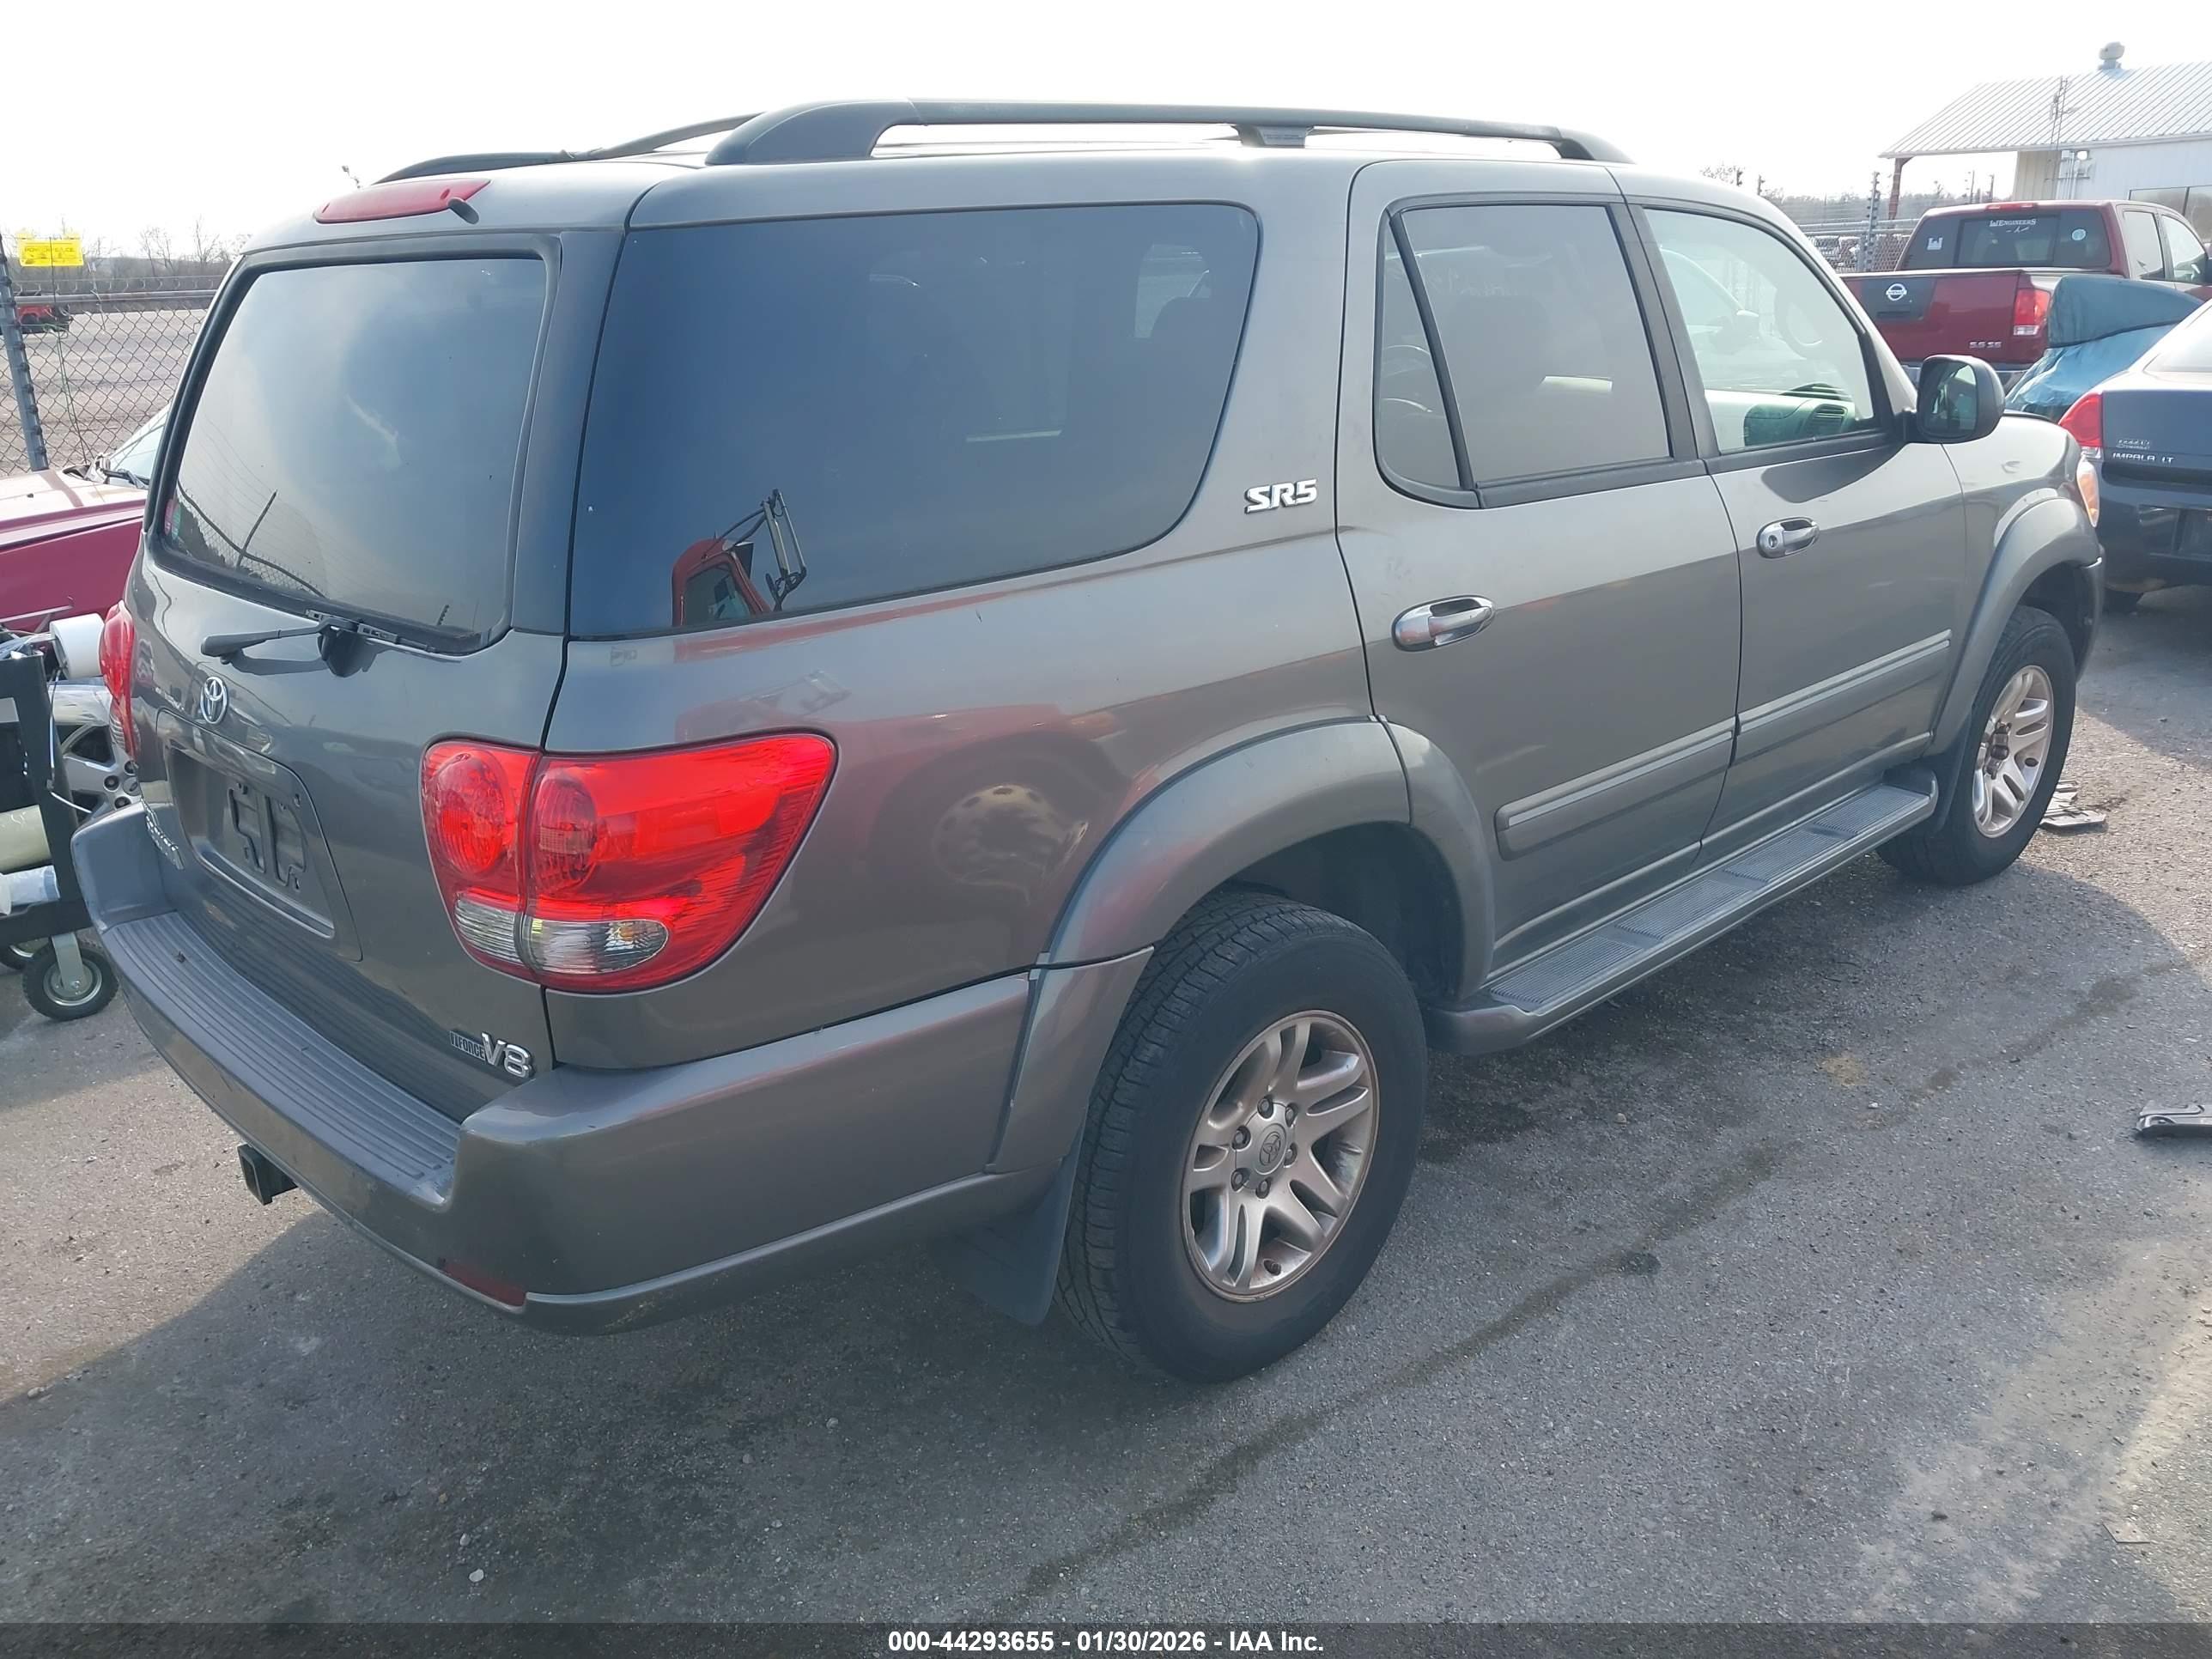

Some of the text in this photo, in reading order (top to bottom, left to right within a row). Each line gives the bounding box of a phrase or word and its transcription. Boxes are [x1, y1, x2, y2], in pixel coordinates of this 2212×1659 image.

[2113, 453, 2155, 461] IMPALA
[1245, 479, 1317, 514] SR5
[482, 1032, 531, 1078] V8
